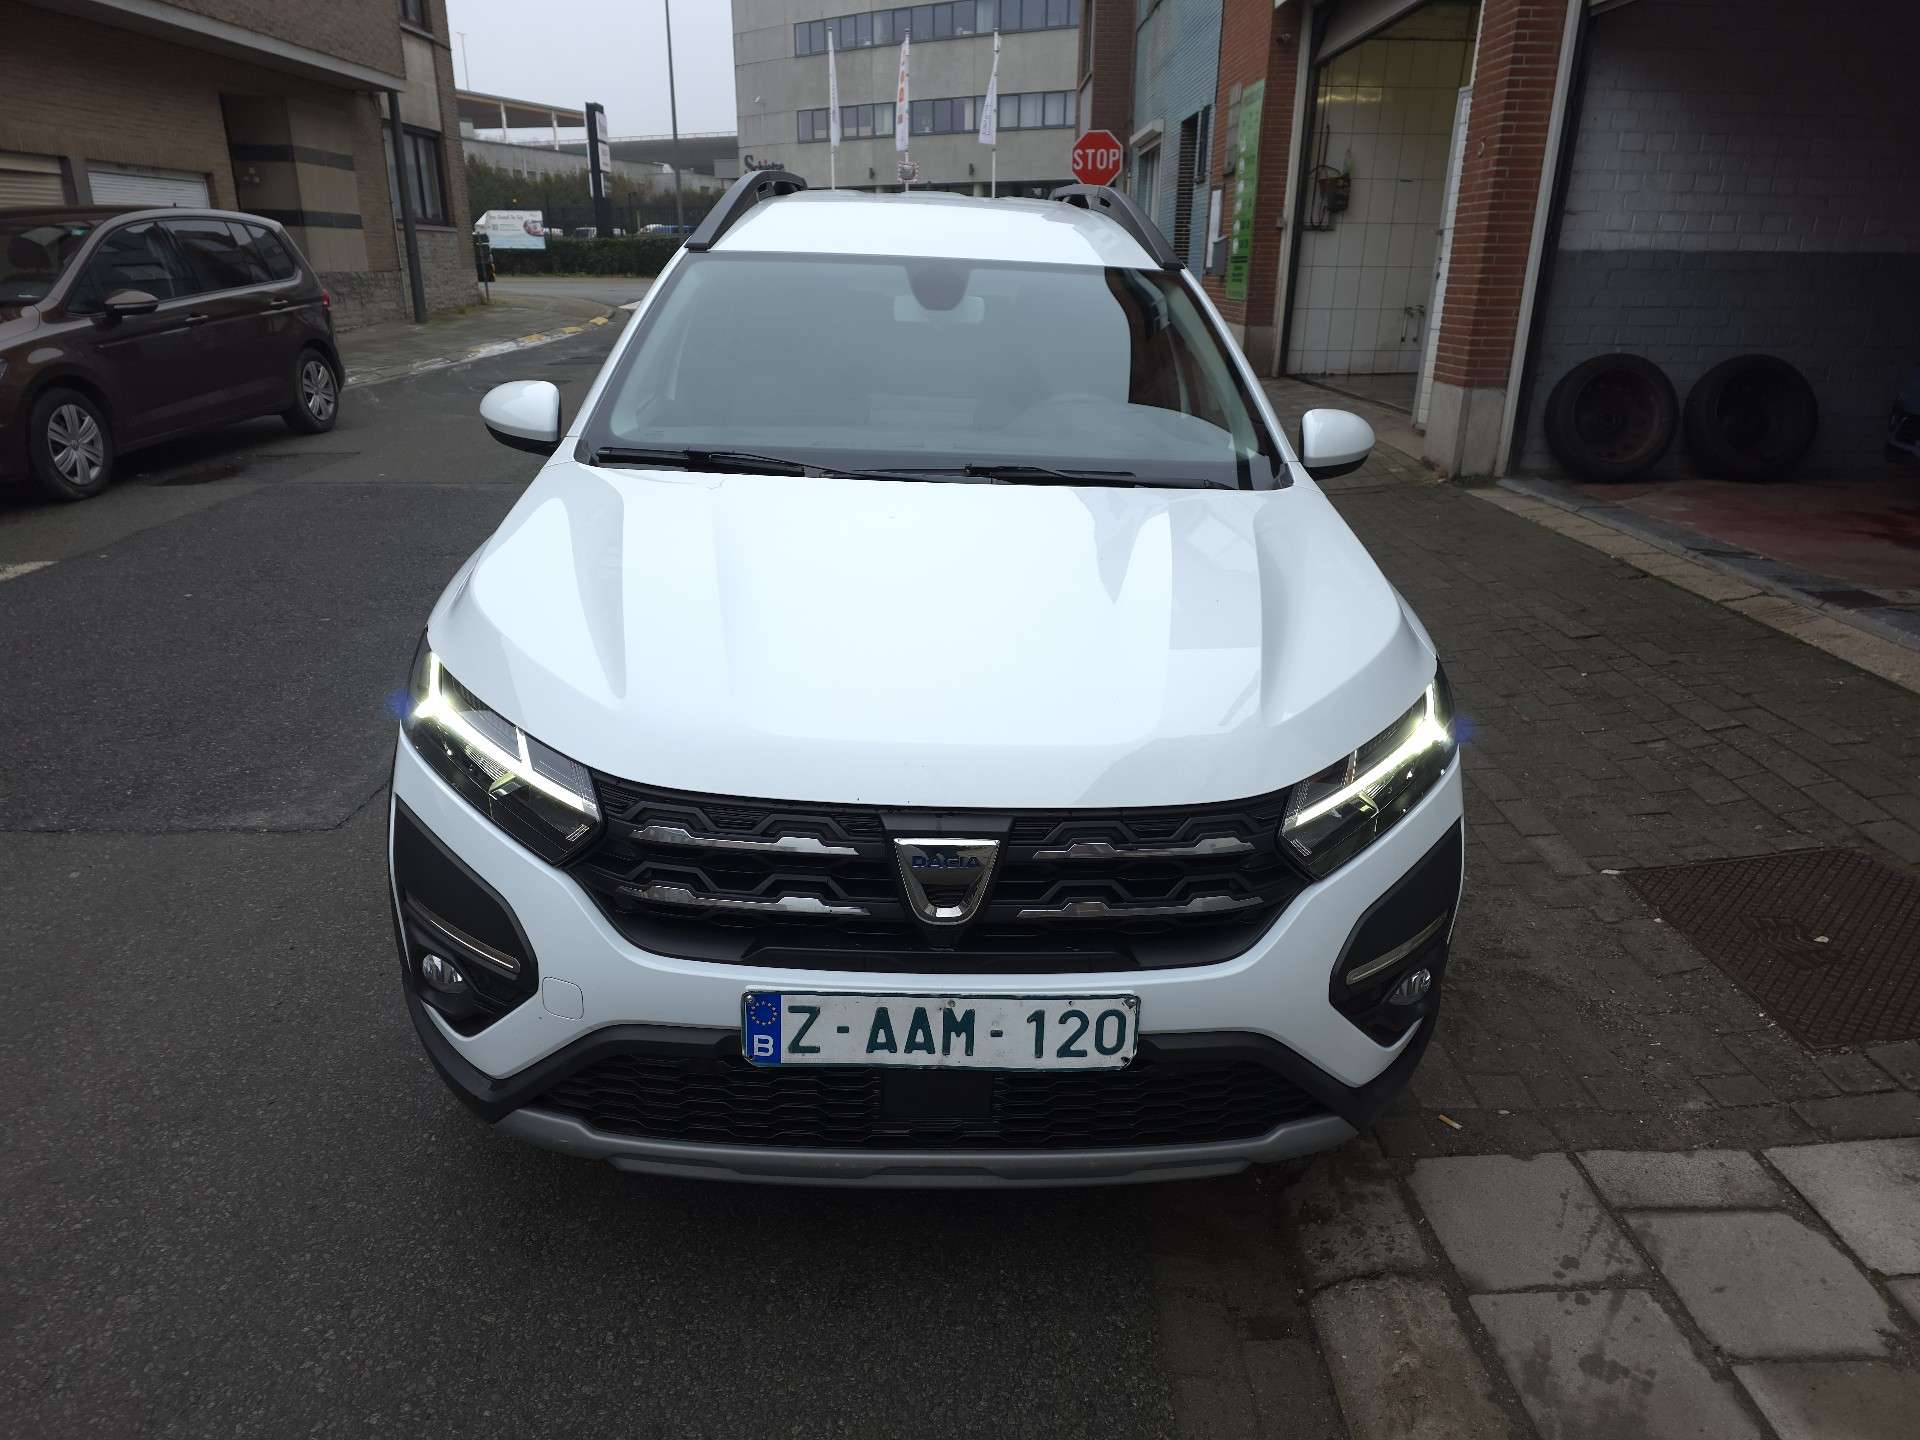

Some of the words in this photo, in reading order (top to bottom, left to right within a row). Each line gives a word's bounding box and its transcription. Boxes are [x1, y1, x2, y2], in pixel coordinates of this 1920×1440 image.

[1073, 148, 1120, 170] STOP
[911, 855, 980, 869] DACIA
[753, 1034, 774, 1057] B
